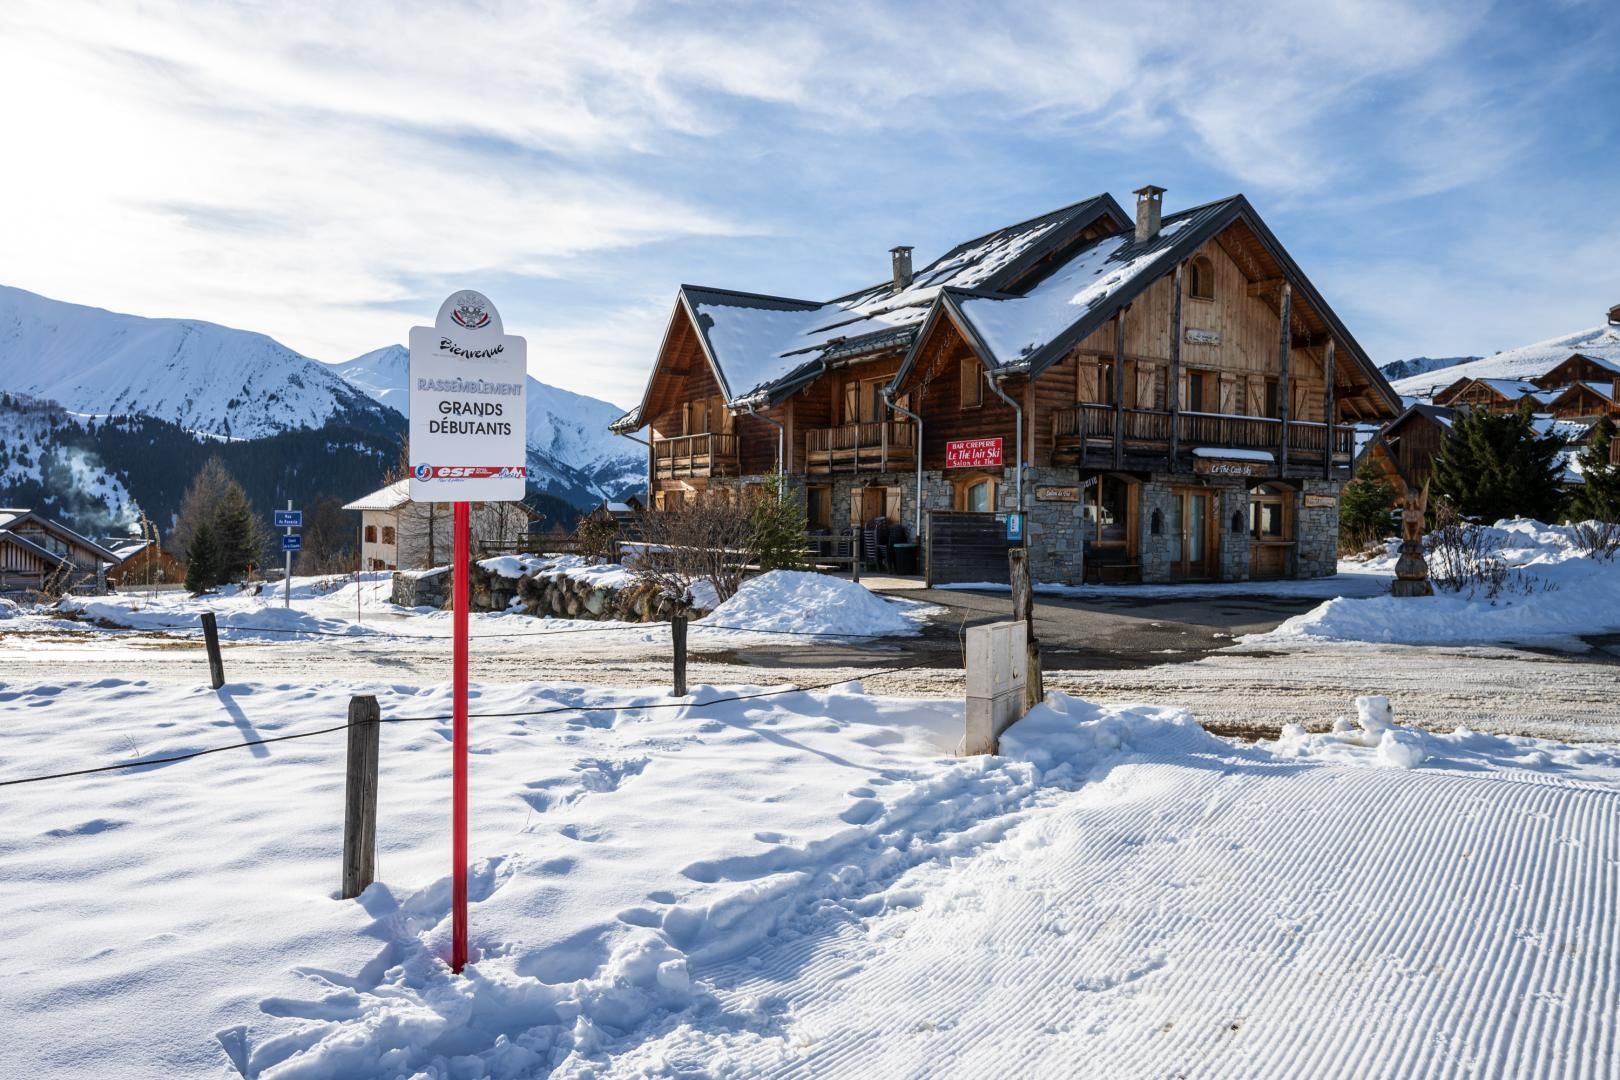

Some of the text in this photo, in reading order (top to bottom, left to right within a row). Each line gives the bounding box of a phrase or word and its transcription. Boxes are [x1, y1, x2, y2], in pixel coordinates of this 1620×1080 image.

[440, 337, 504, 359] Bienvenue
[417, 378, 522, 396] RASSEMBLEMENT
[438, 400, 503, 416] GRANDS
[429, 417, 511, 435] DÉBUTANTS
[987, 447, 1000, 458] Ski
[953, 459, 970, 467] Salon
